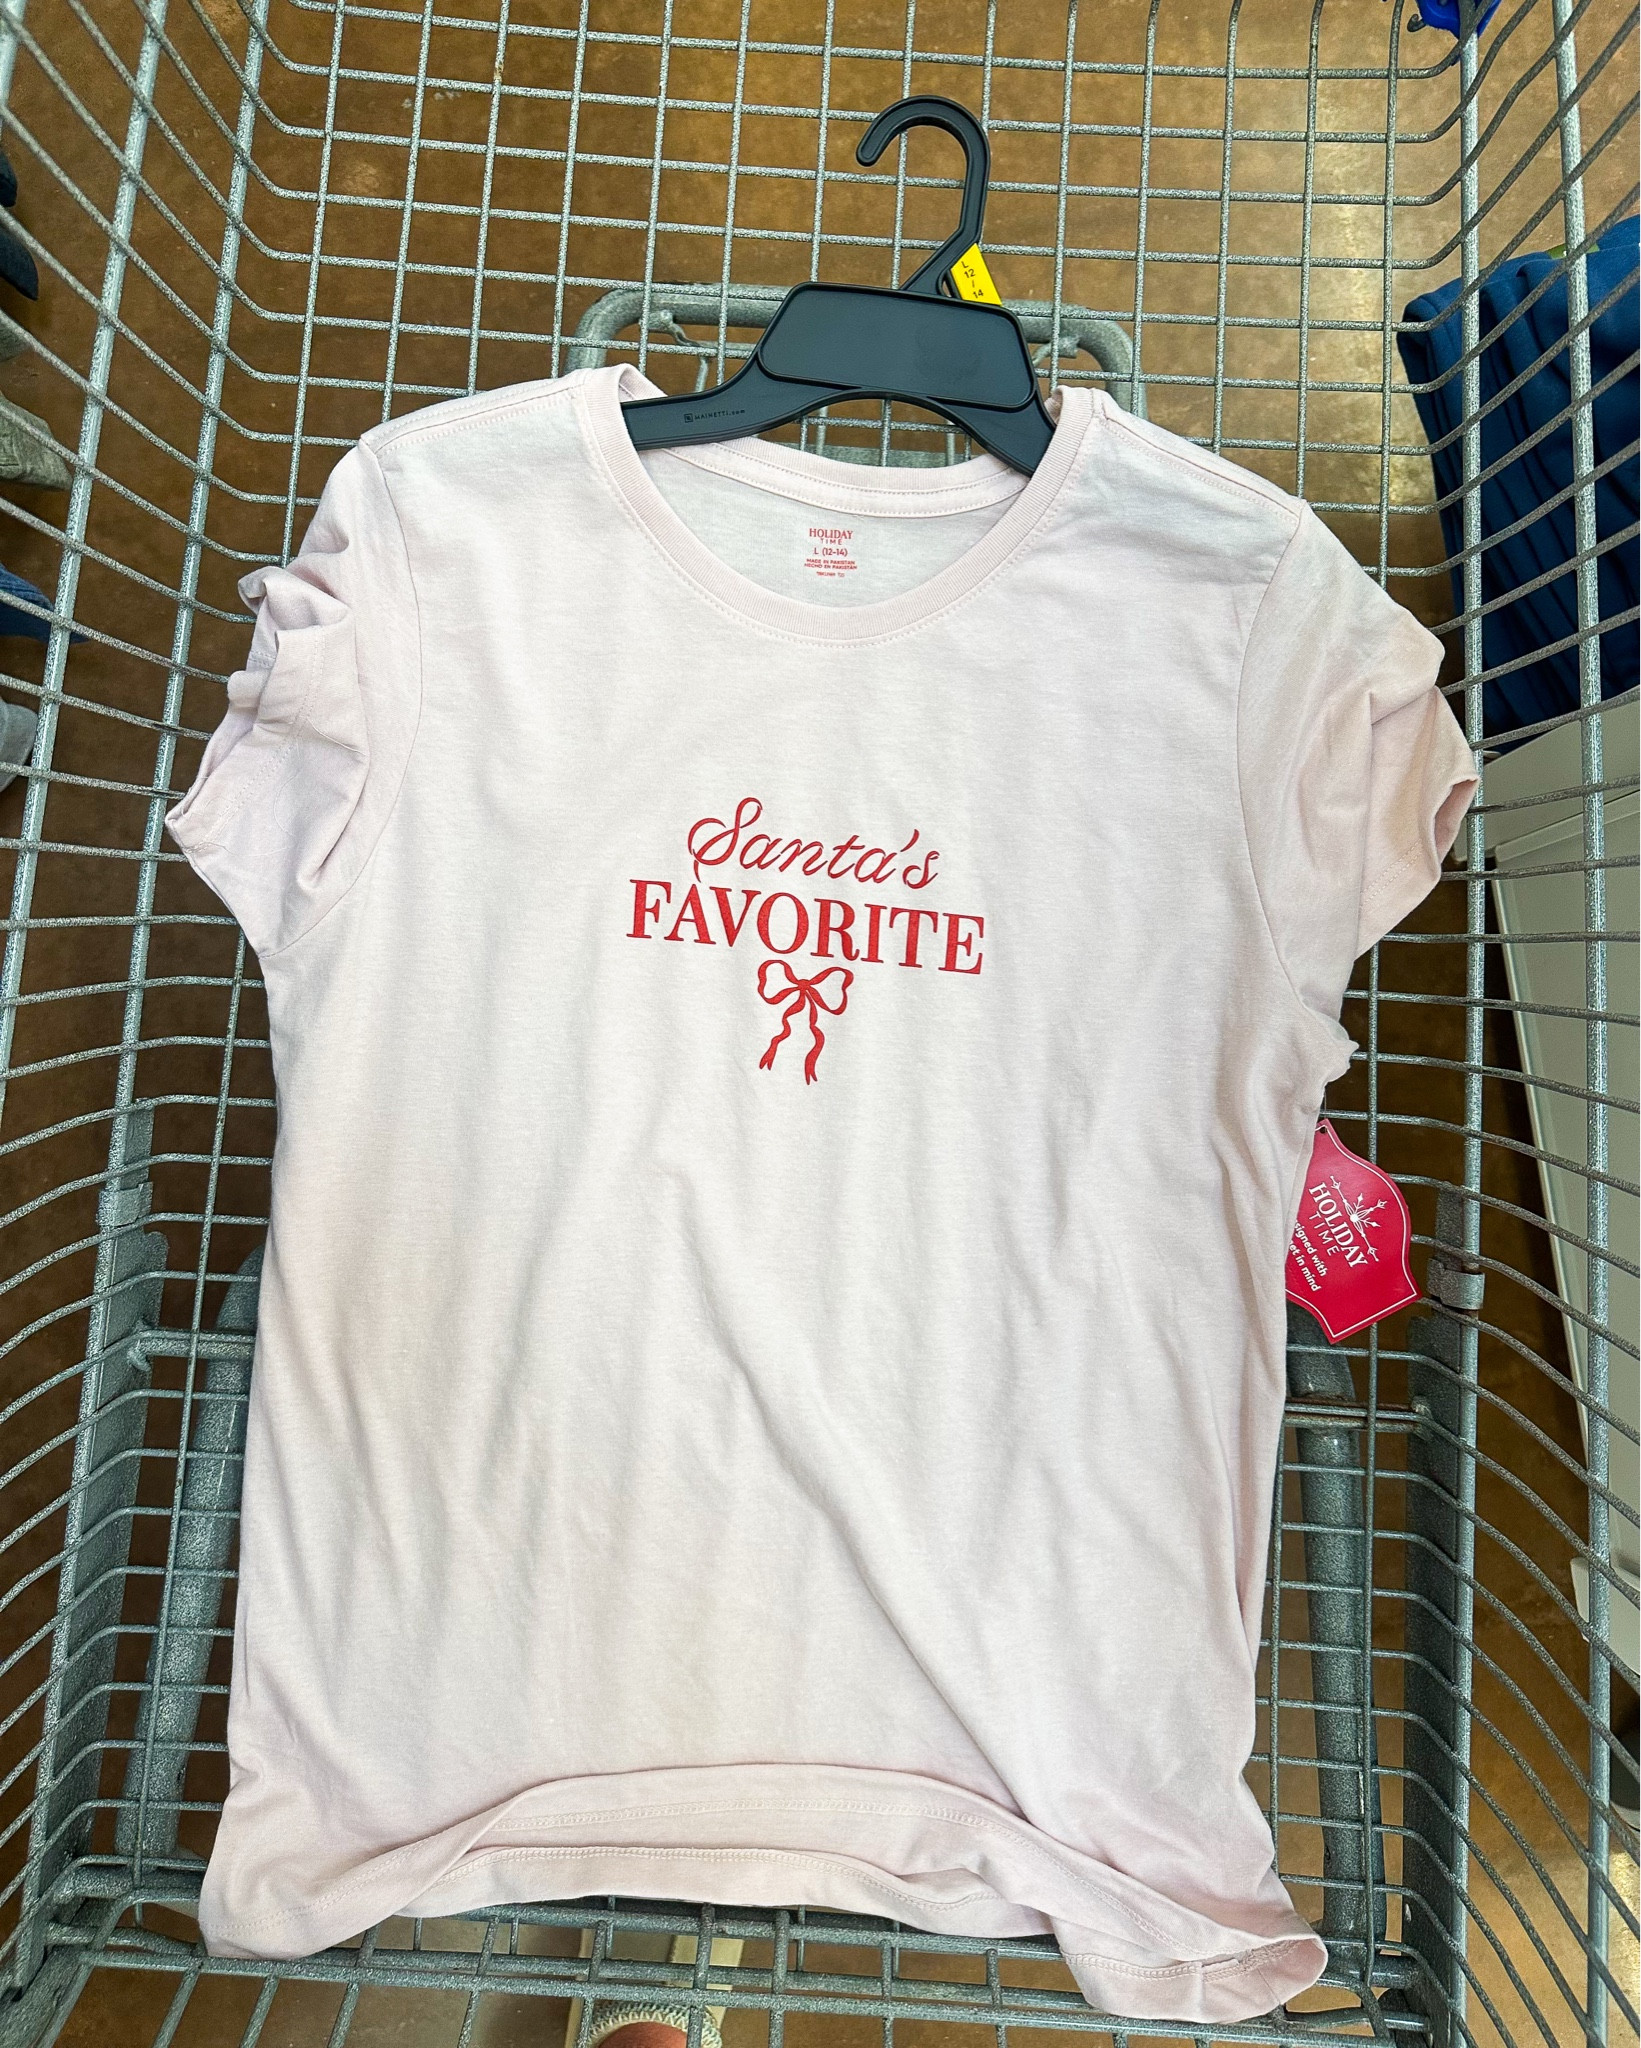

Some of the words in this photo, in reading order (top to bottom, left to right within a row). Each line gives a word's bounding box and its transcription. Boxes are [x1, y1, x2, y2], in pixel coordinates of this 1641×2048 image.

[964, 269, 976, 278] 12
[973, 289, 984, 298] 14
[809, 528, 853, 539] HOLIDAY
[814, 547, 819, 555] L
[822, 547, 848, 557] (12-14)
[688, 797, 940, 889] Santa's
[626, 879, 984, 974] FAVORITE
[1309, 1182, 1368, 1268] HOLIDAY
[1309, 1211, 1340, 1256] TIME
[1295, 1221, 1317, 1254] signed
[1312, 1253, 1328, 1277] with
[1295, 1254, 1305, 1267] in
[1301, 1266, 1322, 1292] mind
